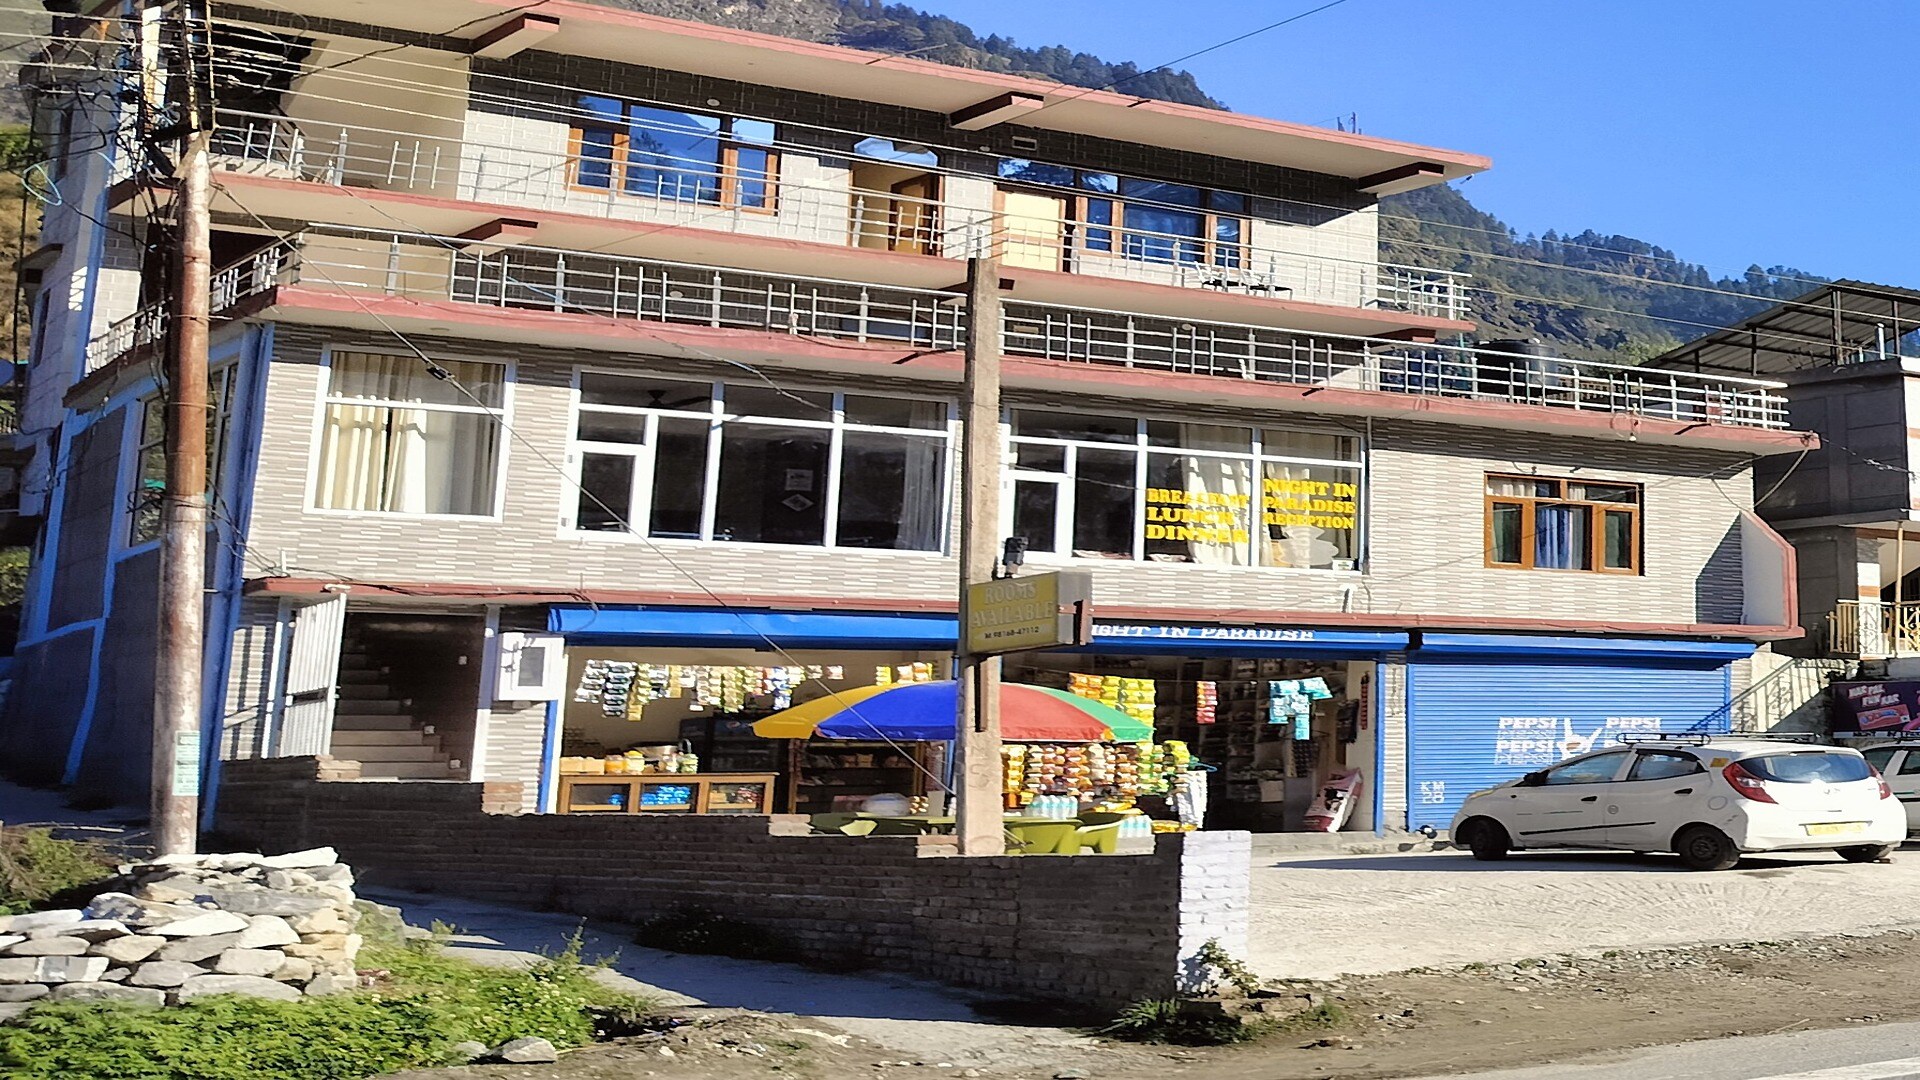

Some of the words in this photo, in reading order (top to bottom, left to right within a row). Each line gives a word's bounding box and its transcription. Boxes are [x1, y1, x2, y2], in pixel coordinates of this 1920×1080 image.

[1263, 478, 1330, 496] NIGHT
[1333, 482, 1357, 498] IN
[1262, 496, 1356, 514] PARADISE
[1147, 507, 1234, 525] LUNCH
[1262, 513, 1355, 529] RECEPTION
[1146, 525, 1248, 543] DINNER
[973, 602, 1053, 628] AVAILABLE
[1091, 625, 1151, 637] IGHT
[1159, 626, 1189, 638] IN
[1202, 627, 1314, 641] PARADISE
[1498, 717, 1557, 729] PEPSI
[1606, 717, 1663, 729] PEPSI
[1496, 740, 1556, 753] PEPSI
